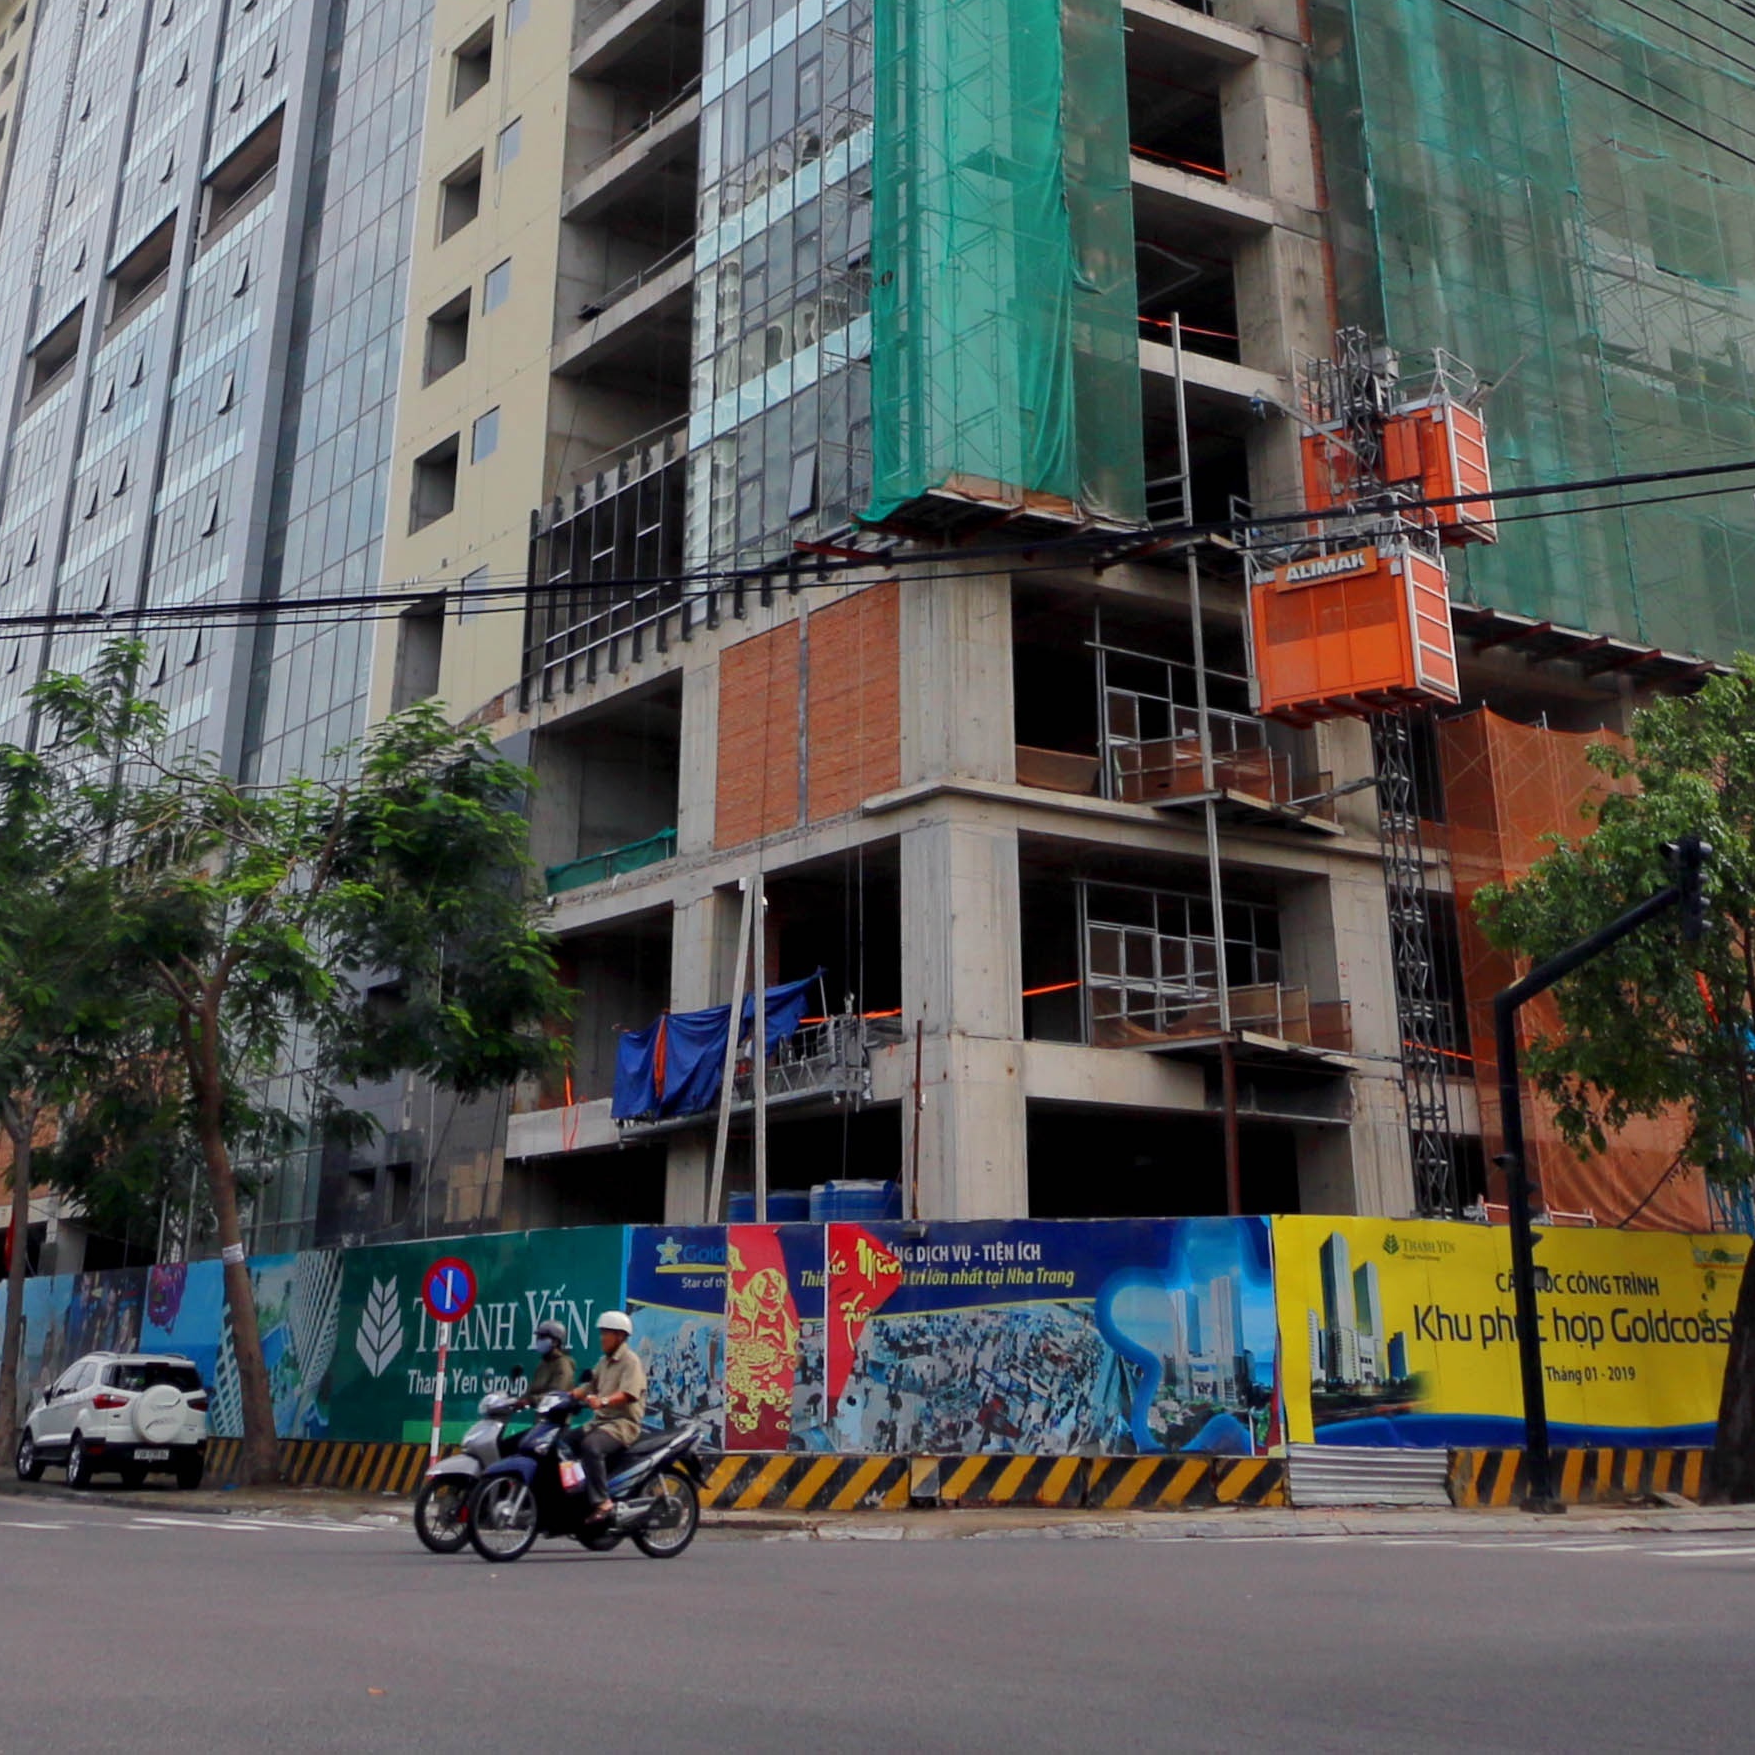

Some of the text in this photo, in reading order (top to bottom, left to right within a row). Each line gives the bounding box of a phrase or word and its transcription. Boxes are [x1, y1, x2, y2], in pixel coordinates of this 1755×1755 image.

[1285, 552, 1366, 582] ALIMAK
[916, 1245, 946, 1265] DỊCH
[952, 1244, 972, 1266] VỤ
[982, 1240, 1014, 1266] TIỆN
[1018, 1241, 1041, 1261] ÍCH
[681, 1277, 701, 1289] Star
[703, 1276, 715, 1288] of
[927, 1268, 948, 1285] lớn
[951, 1267, 983, 1285] nhất
[985, 1269, 1005, 1289] tại
[1006, 1268, 1034, 1285] Nha
[1037, 1267, 1075, 1288] Trang
[1567, 1271, 1611, 1296] CÔNG
[1612, 1271, 1660, 1296] TRÌNH
[1413, 1304, 1473, 1342] Khu
[1553, 1307, 1605, 1351] hợp
[453, 1368, 477, 1395] Yen
[1545, 1365, 1582, 1386] Tháng
[1584, 1366, 1598, 1382] 01
[1607, 1366, 1636, 1381] 2019
